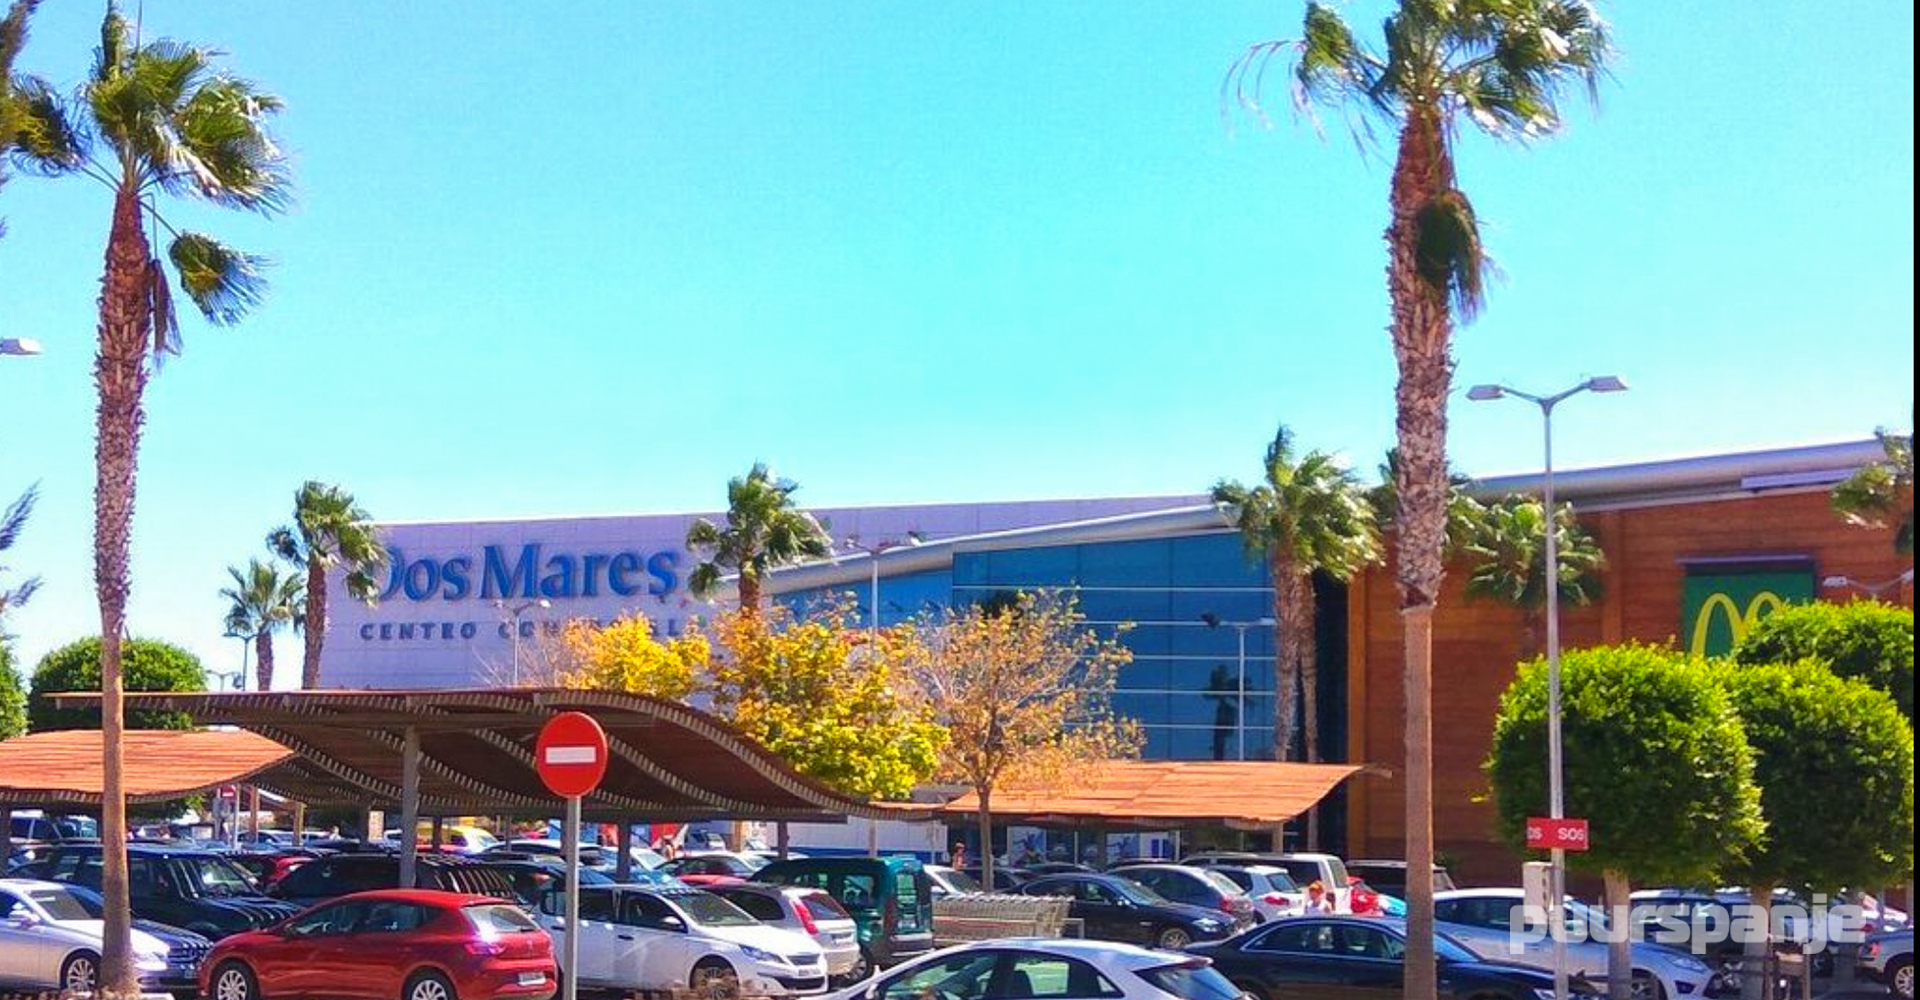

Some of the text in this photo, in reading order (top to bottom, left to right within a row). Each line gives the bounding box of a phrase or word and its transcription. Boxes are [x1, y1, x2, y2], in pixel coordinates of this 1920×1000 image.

[479, 543, 678, 601] Mares
[359, 621, 478, 641] CENTRO
[1557, 827, 1585, 841] SOS
